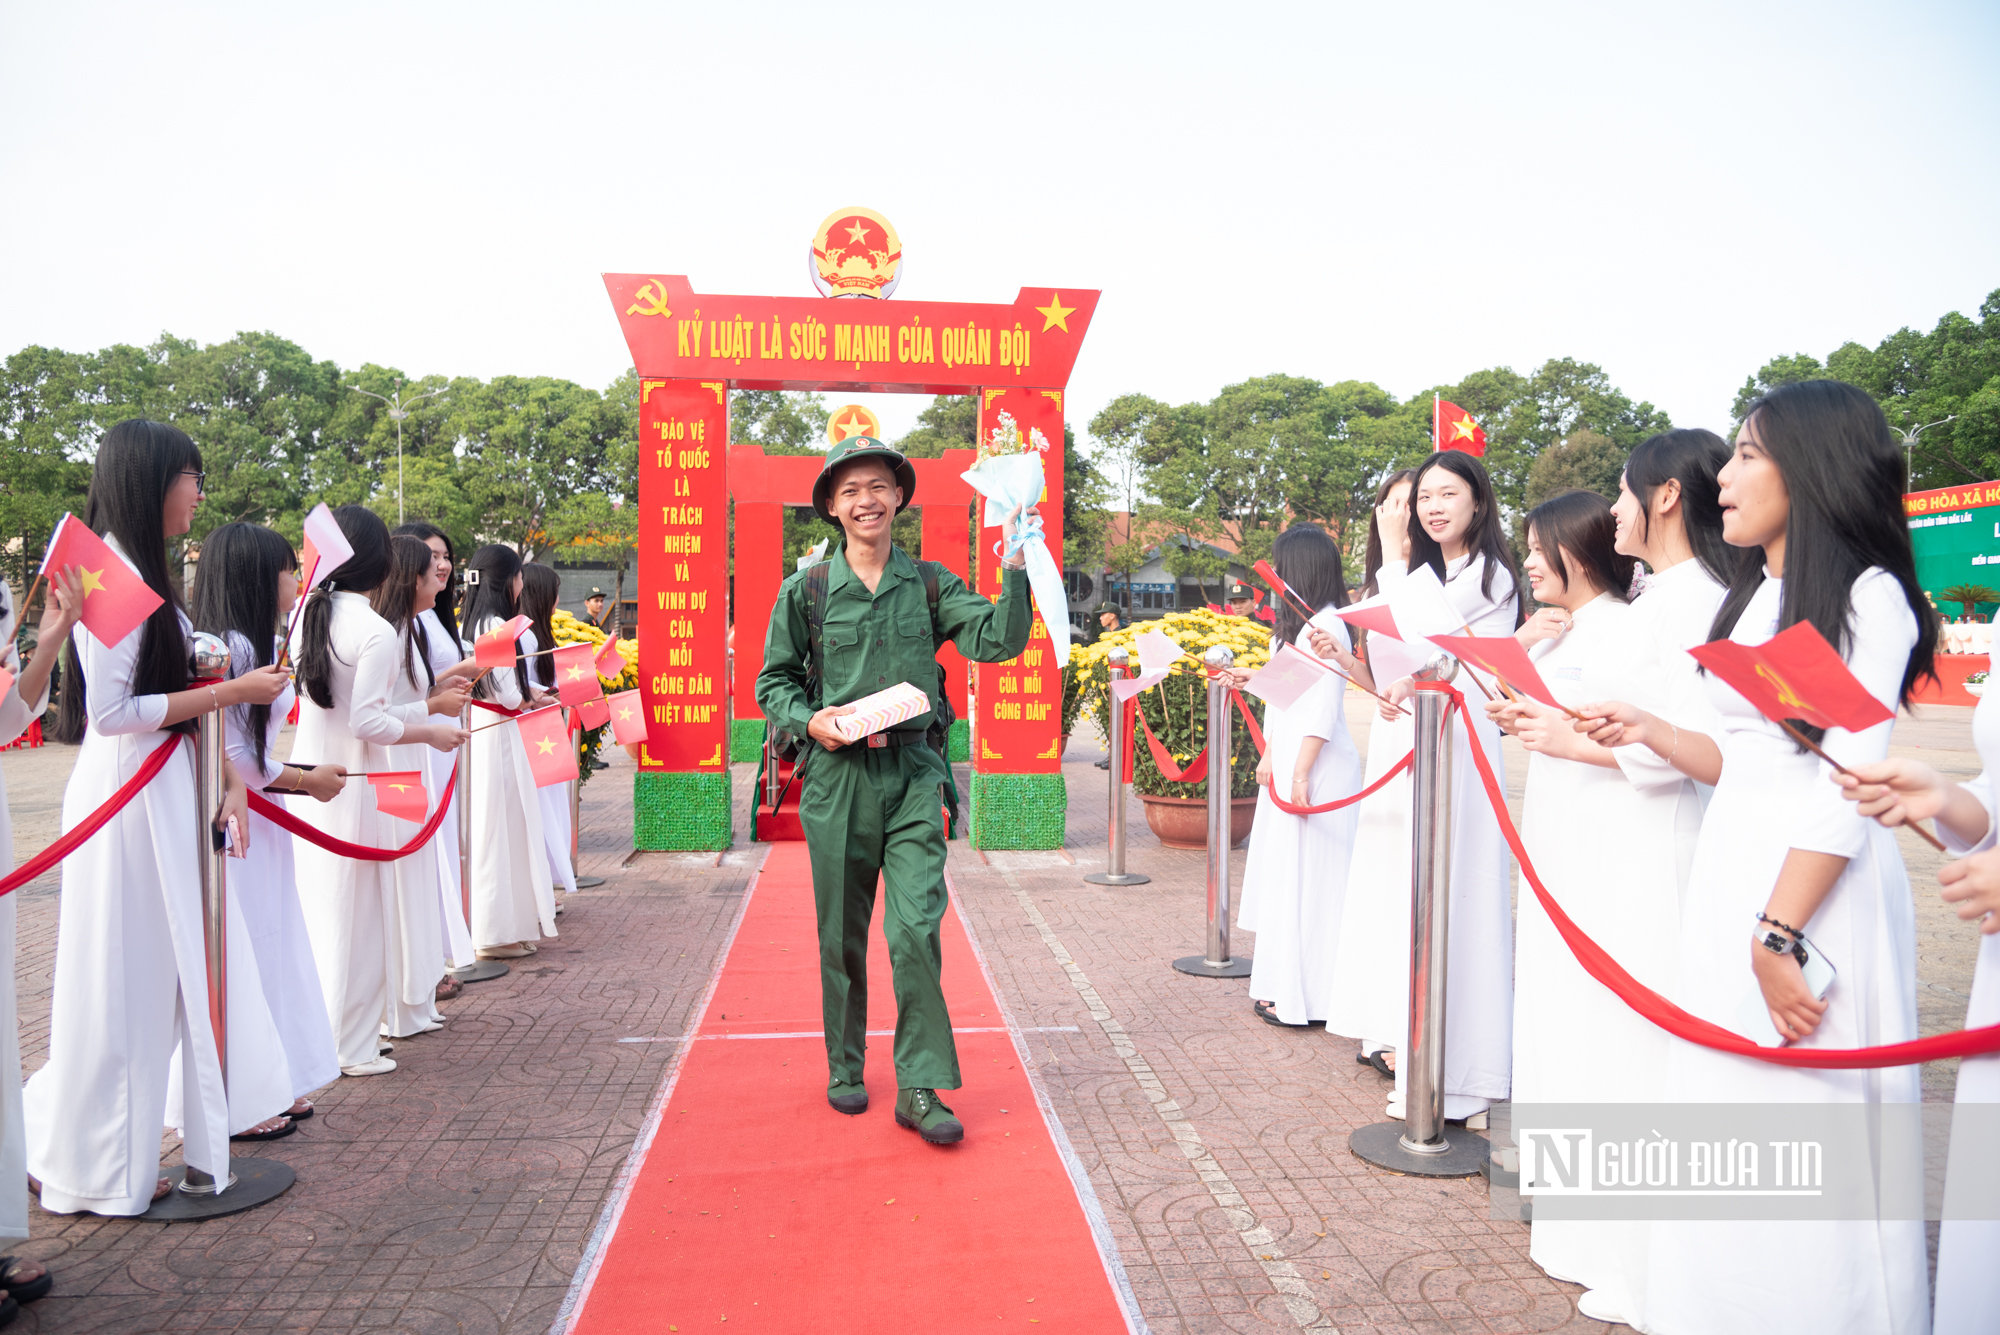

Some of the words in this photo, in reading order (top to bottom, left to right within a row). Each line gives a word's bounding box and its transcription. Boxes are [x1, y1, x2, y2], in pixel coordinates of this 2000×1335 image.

[678, 308, 704, 358] KỶ
[710, 313, 754, 366] LUẬT
[760, 314, 784, 360] LÀ
[789, 315, 827, 361] SỨC
[834, 324, 891, 371] MẠNH
[898, 315, 935, 364] CỦA
[941, 321, 991, 369] QUÂN
[999, 324, 1031, 376] ĐỘI
[653, 417, 685, 441] "BẢO
[690, 419, 705, 444] VỆ
[656, 443, 672, 469] TỔ
[679, 445, 710, 471] QUỐC
[674, 475, 691, 497] LÀ
[1930, 492, 1960, 510] HÒA
[1962, 488, 1983, 506] XÃ
[662, 503, 703, 525] TRÁCH
[664, 531, 701, 557] NHIỆM
[674, 560, 690, 582] VÀ
[657, 591, 686, 610] VINH
[690, 589, 707, 614] DỰ
[669, 615, 694, 639] CỦA
[669, 642, 693, 667] MỖI
[652, 672, 684, 695] CÔNG
[688, 672, 712, 695] DÂN
[999, 671, 1018, 694] CỦA
[1023, 670, 1042, 694] MỖI
[653, 702, 681, 726] VIỆT
[684, 704, 718, 723] NAM"
[994, 699, 1021, 720] CÔNG
[1026, 699, 1052, 721] DÂN"
